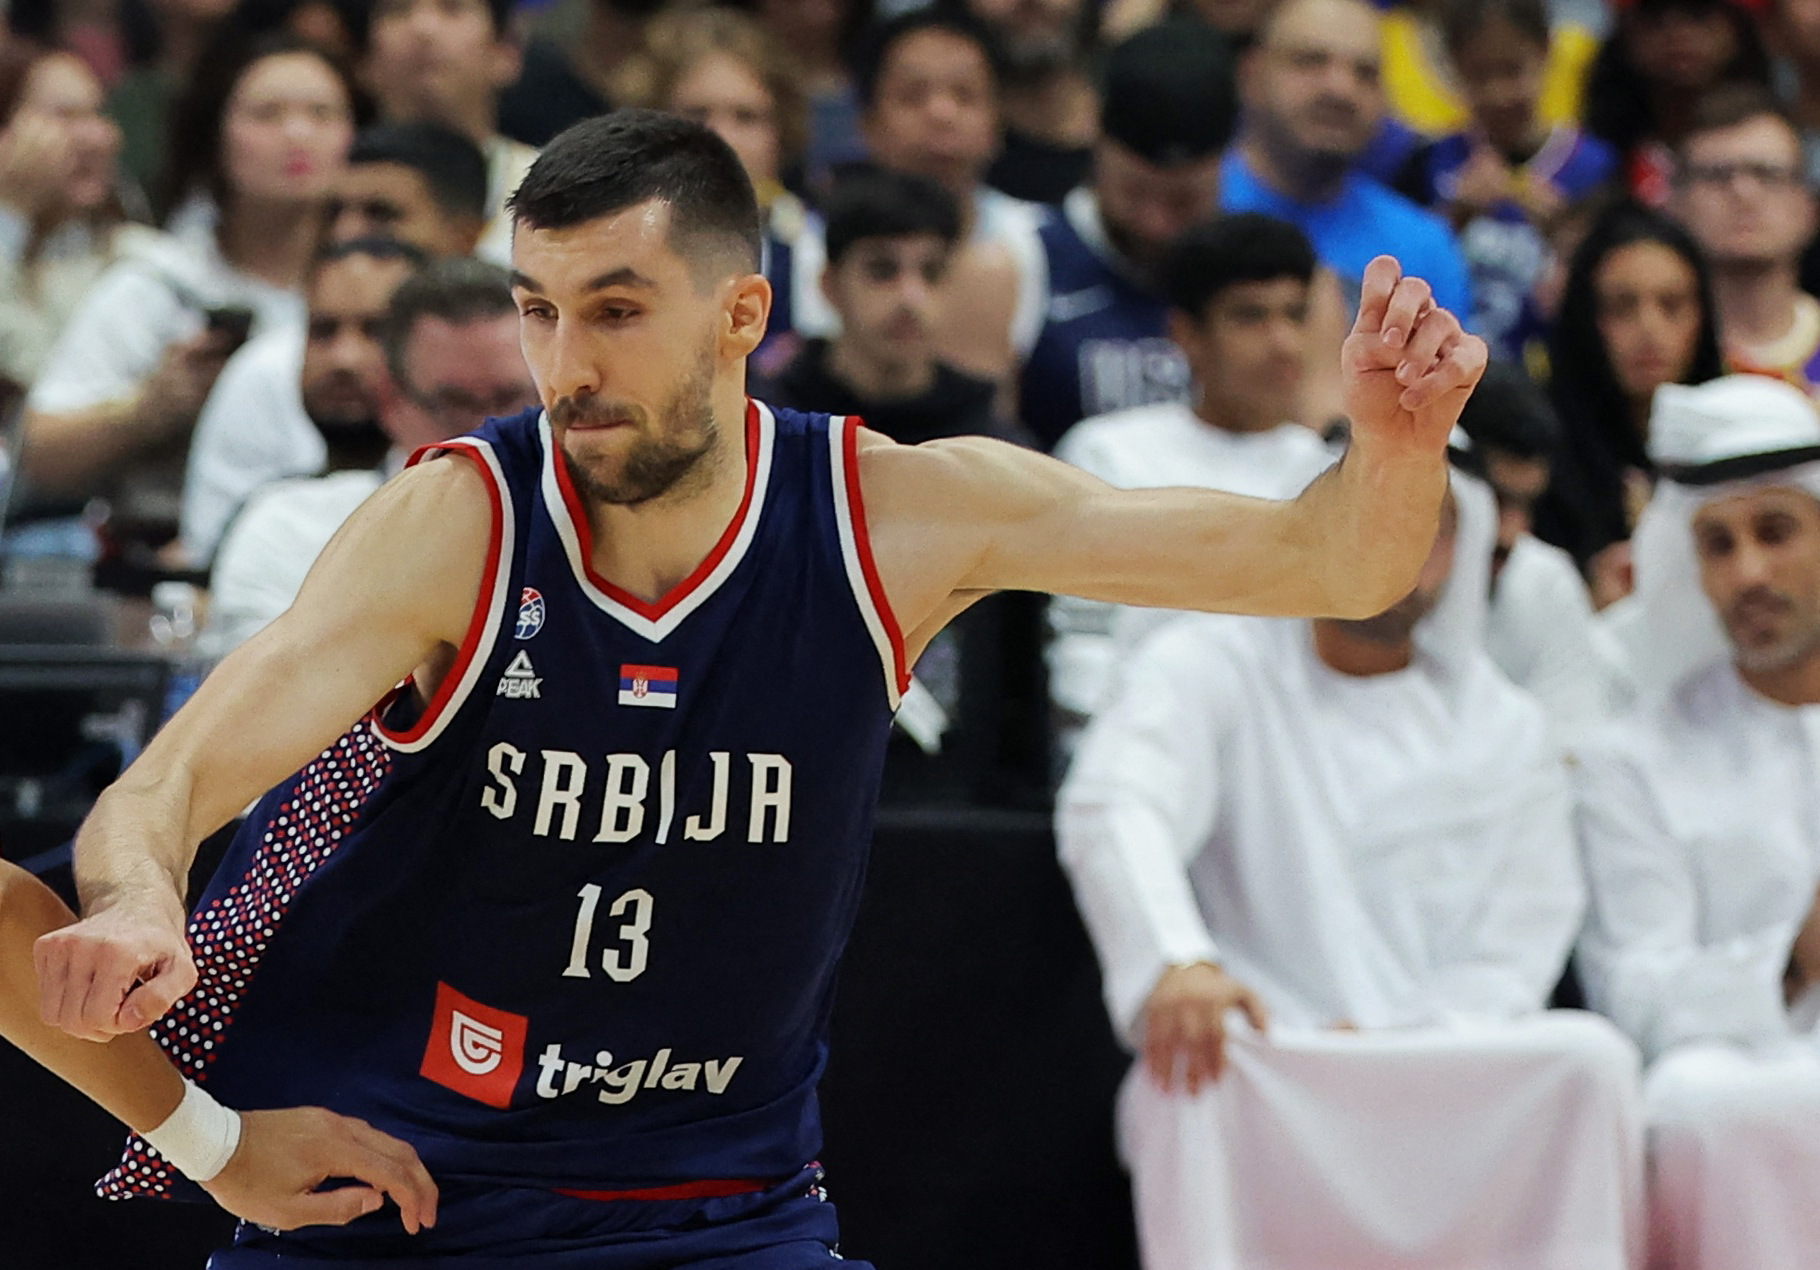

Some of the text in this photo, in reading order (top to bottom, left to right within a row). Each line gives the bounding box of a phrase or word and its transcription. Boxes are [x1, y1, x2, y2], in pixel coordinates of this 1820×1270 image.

[496, 677, 544, 699] PEAK
[481, 741, 793, 845] SRBIJA
[562, 883, 654, 982] 13
[536, 1043, 744, 1105] triglav
